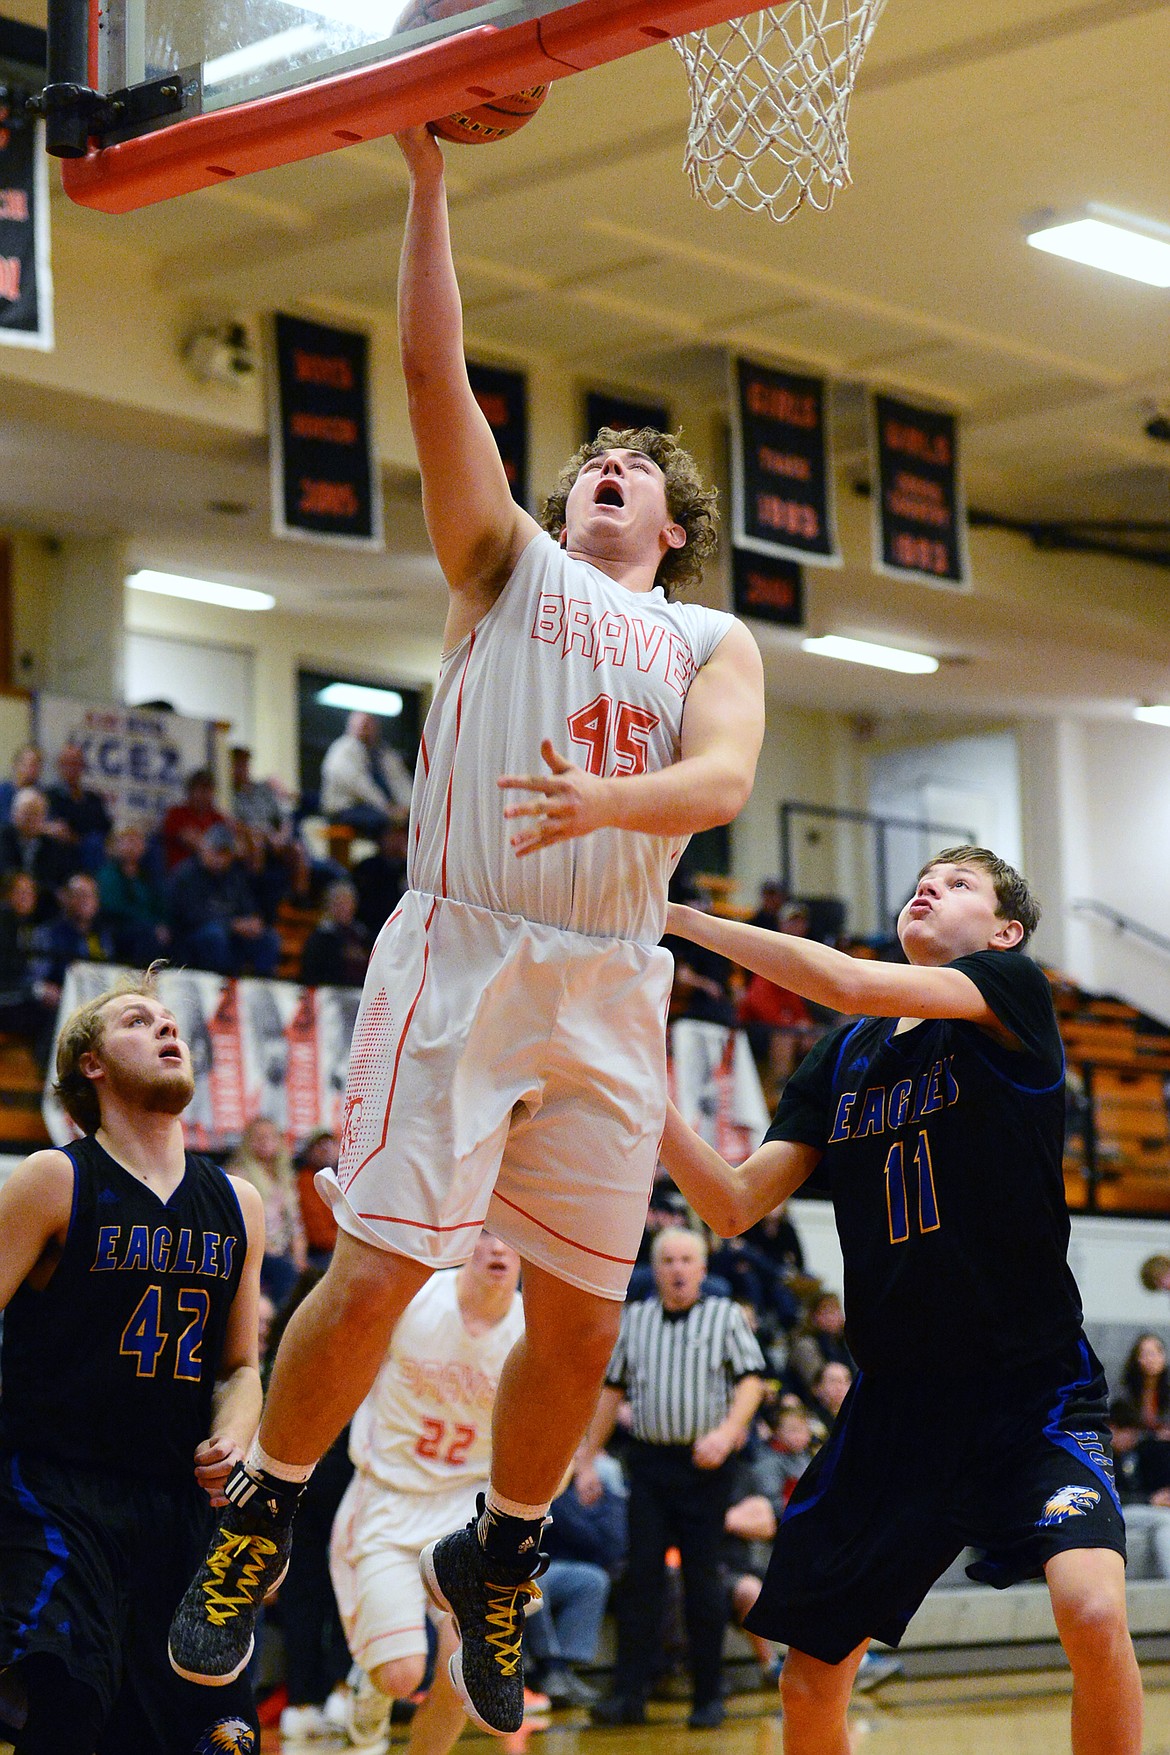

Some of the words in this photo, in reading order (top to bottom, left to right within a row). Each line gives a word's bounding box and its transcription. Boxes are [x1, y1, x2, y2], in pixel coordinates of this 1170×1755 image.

[531, 592, 700, 698] BRAVE
[567, 693, 661, 778] 45
[828, 1054, 960, 1144] EAGLES
[883, 1129, 941, 1245] 11
[90, 1225, 237, 1280] EAGLES
[119, 1285, 211, 1383] 42
[415, 1415, 477, 1466] 22
